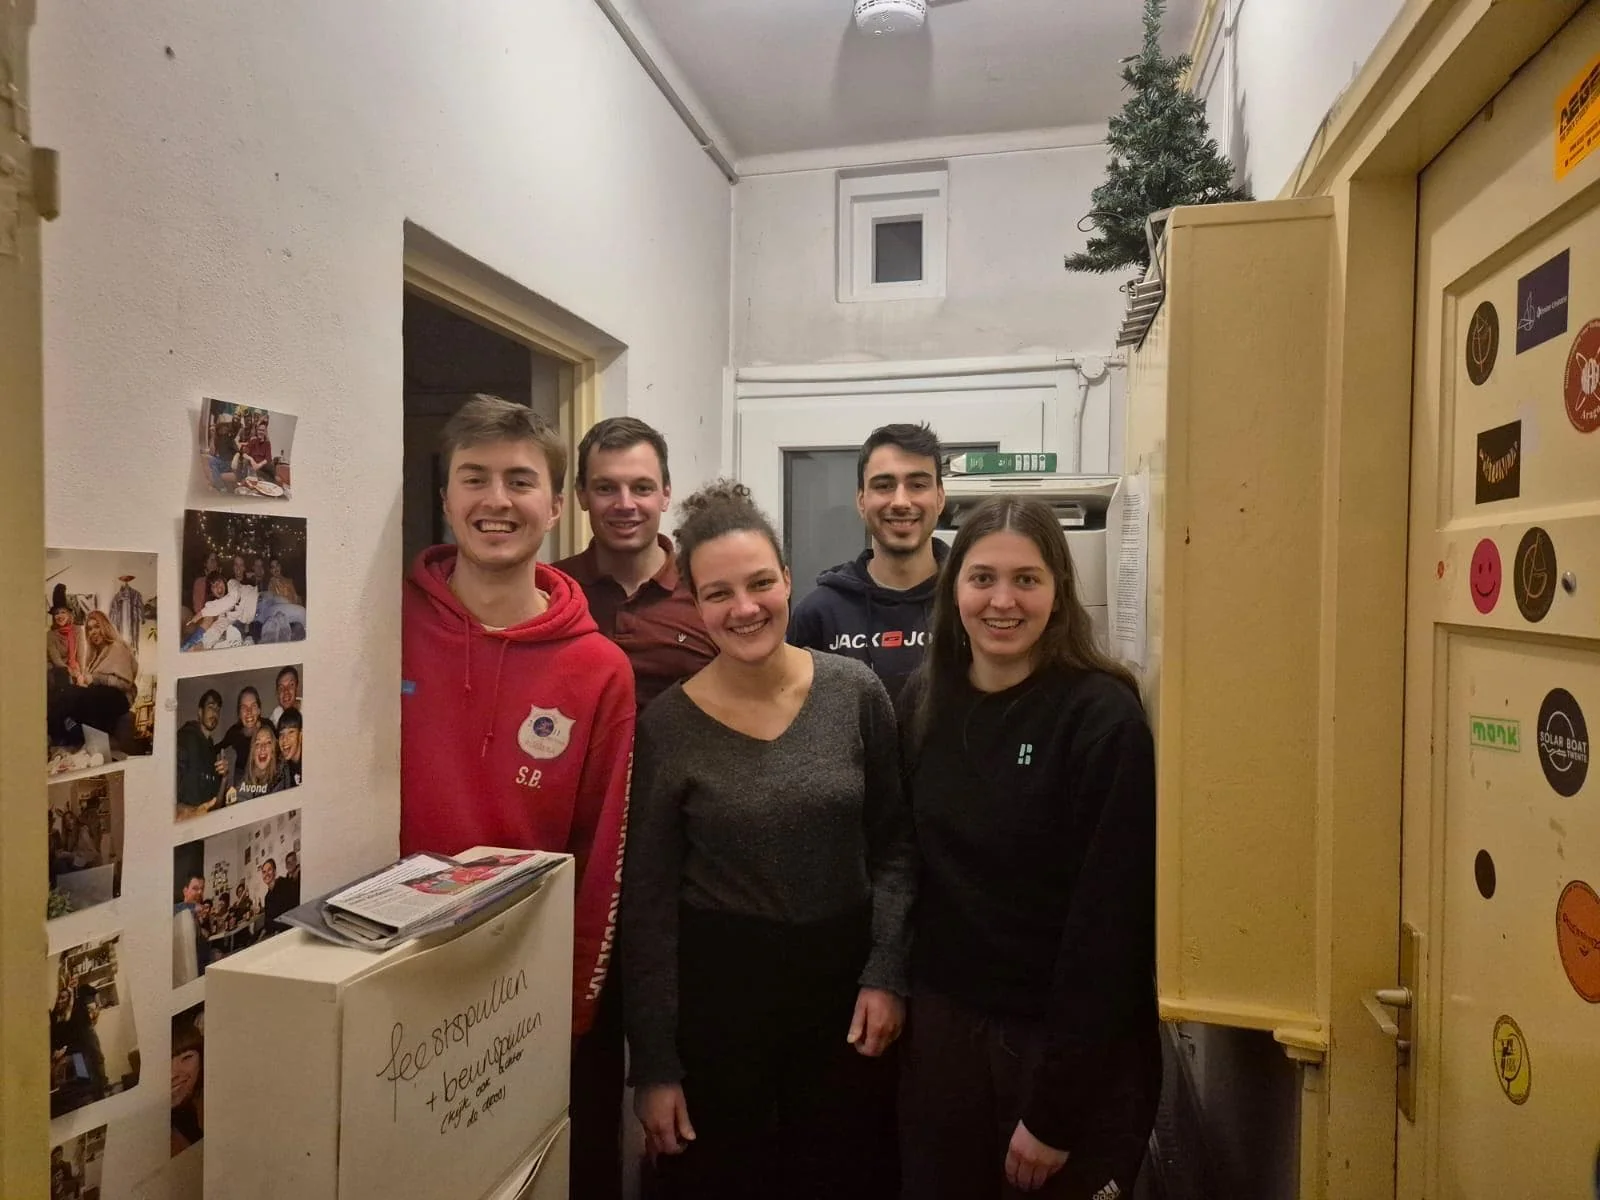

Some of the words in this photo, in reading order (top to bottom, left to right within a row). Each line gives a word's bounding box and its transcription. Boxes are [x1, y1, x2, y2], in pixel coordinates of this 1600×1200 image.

[1540, 730, 1564, 748] SOLAR
[1566, 737, 1587, 754] BOAT
[239, 781, 268, 794] Avond
[376, 969, 528, 1123] feestspullen
